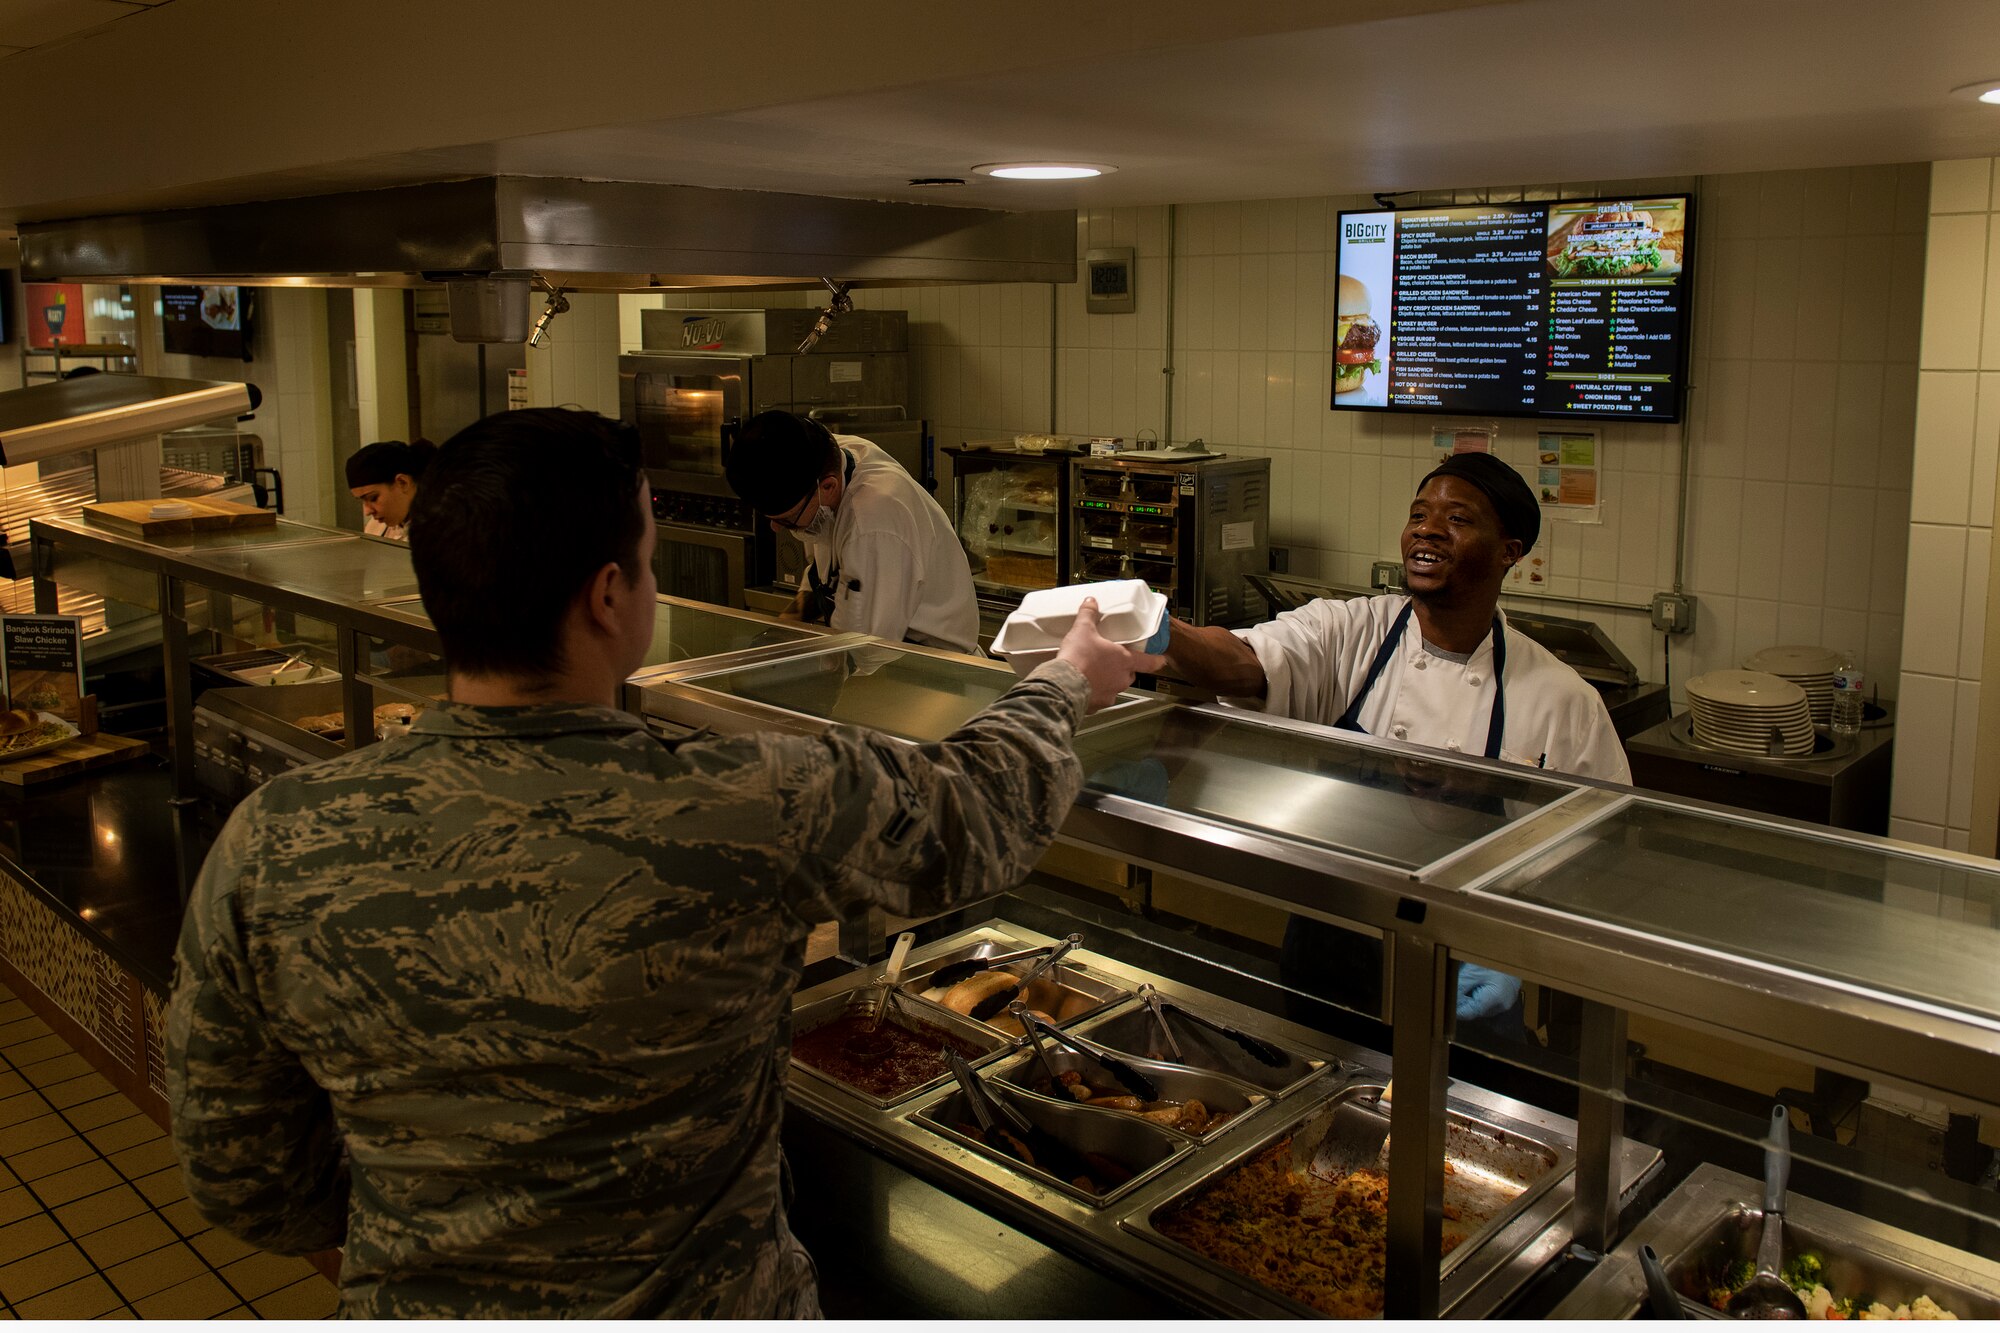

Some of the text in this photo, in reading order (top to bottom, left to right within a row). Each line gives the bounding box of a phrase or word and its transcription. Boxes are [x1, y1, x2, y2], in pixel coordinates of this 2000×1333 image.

[6, 625, 74, 634] Bangkok Sriracha
[35, 636, 67, 644] Chicken
